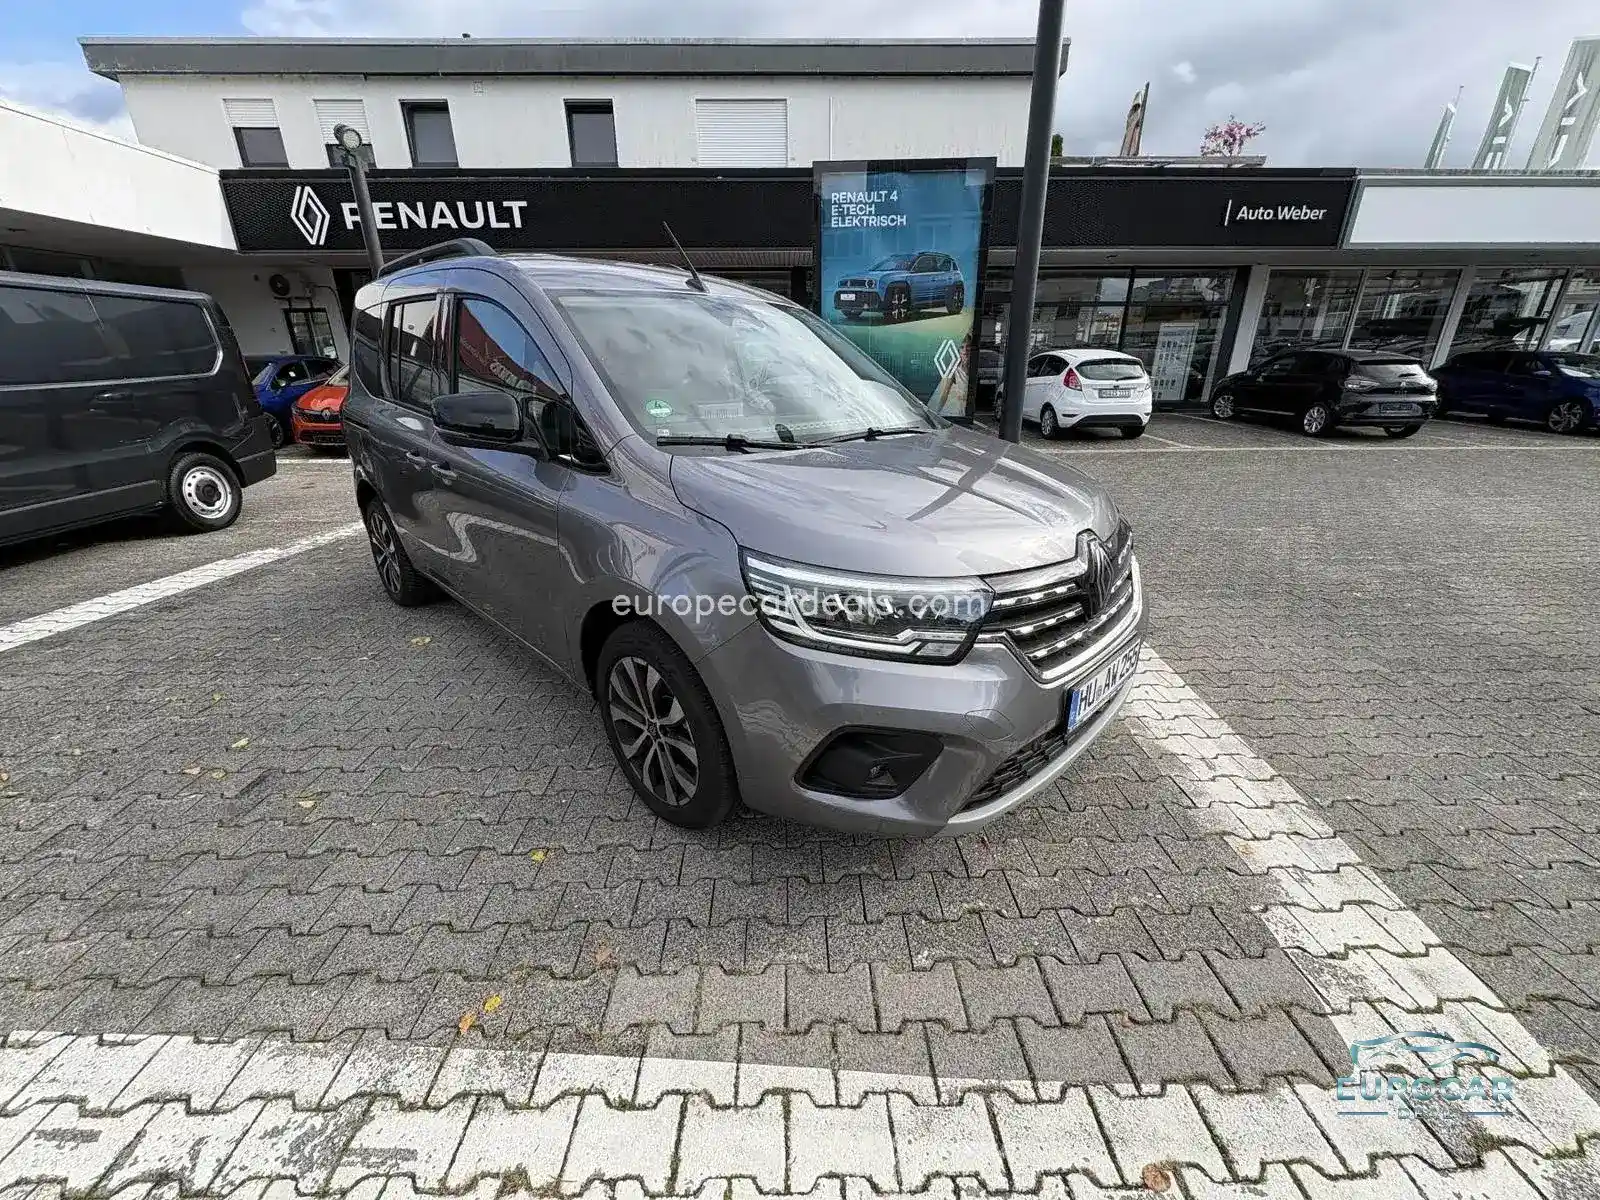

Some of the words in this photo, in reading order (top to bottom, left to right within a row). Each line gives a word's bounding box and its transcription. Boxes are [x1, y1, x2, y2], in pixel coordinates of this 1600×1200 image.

[832, 191, 888, 204] RENAULT
[889, 190, 899, 202] 4
[340, 201, 528, 230] RENAULT
[831, 204, 875, 216] E-TECH
[1236, 205, 1274, 220] Auto
[1277, 205, 1328, 220] Weber
[831, 215, 907, 228] ELEKTRISCH
